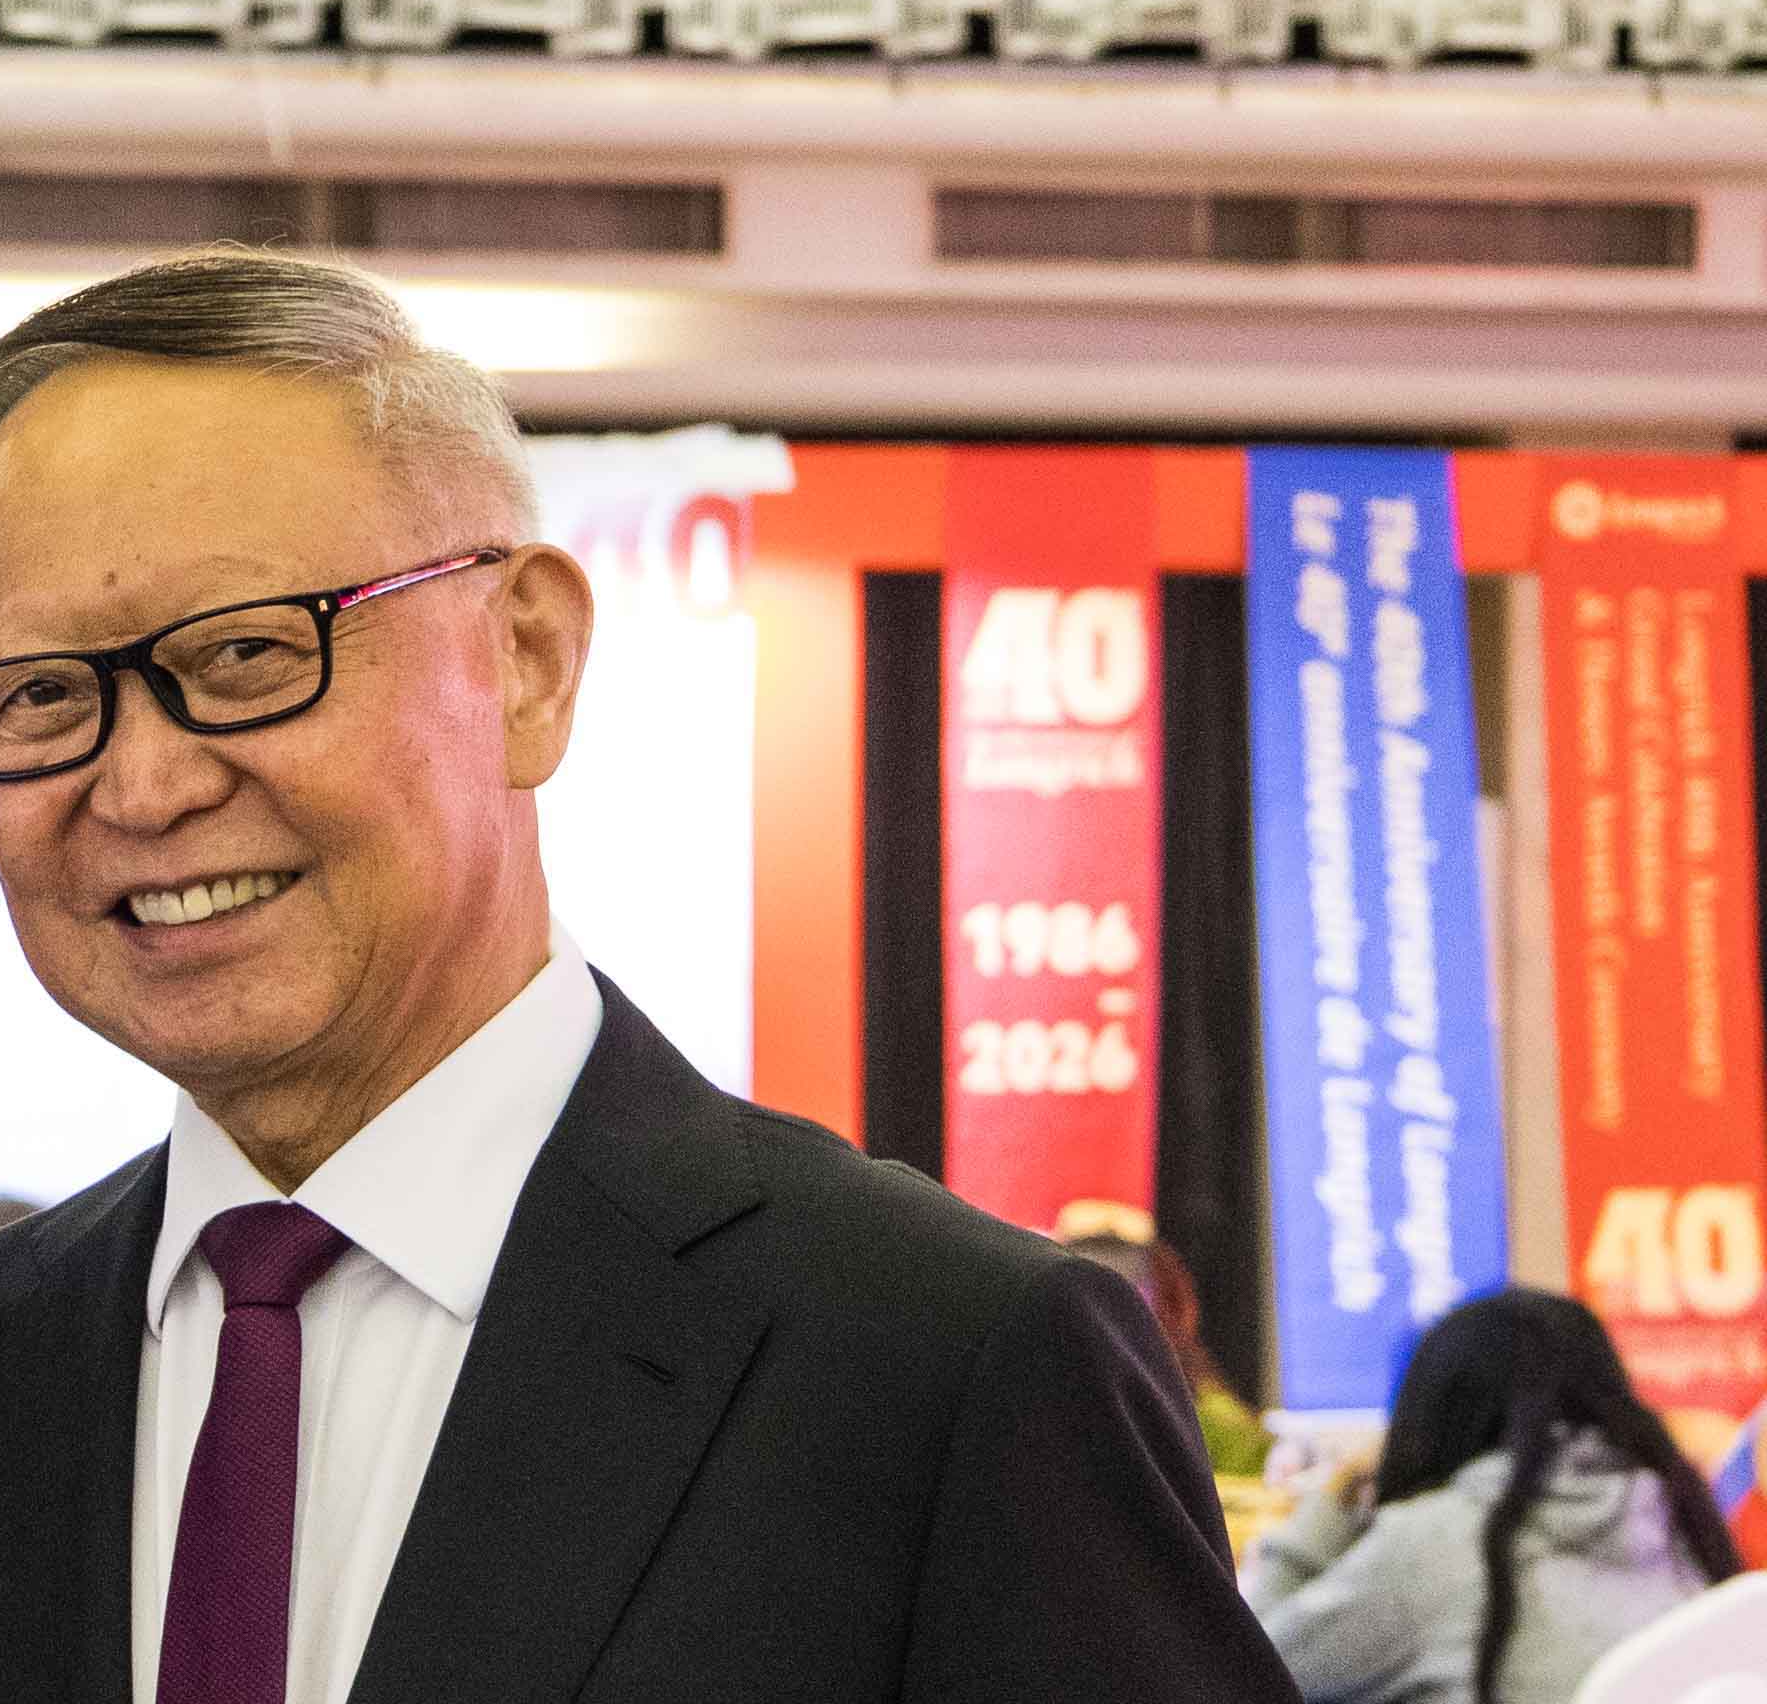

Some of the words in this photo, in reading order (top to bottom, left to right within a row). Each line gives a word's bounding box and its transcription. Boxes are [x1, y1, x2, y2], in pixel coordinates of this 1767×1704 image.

[960, 586, 1146, 726] 40
[960, 899, 1141, 979] 1986
[958, 1017, 1140, 1096] 2026
[1584, 1184, 1762, 1316] 40
